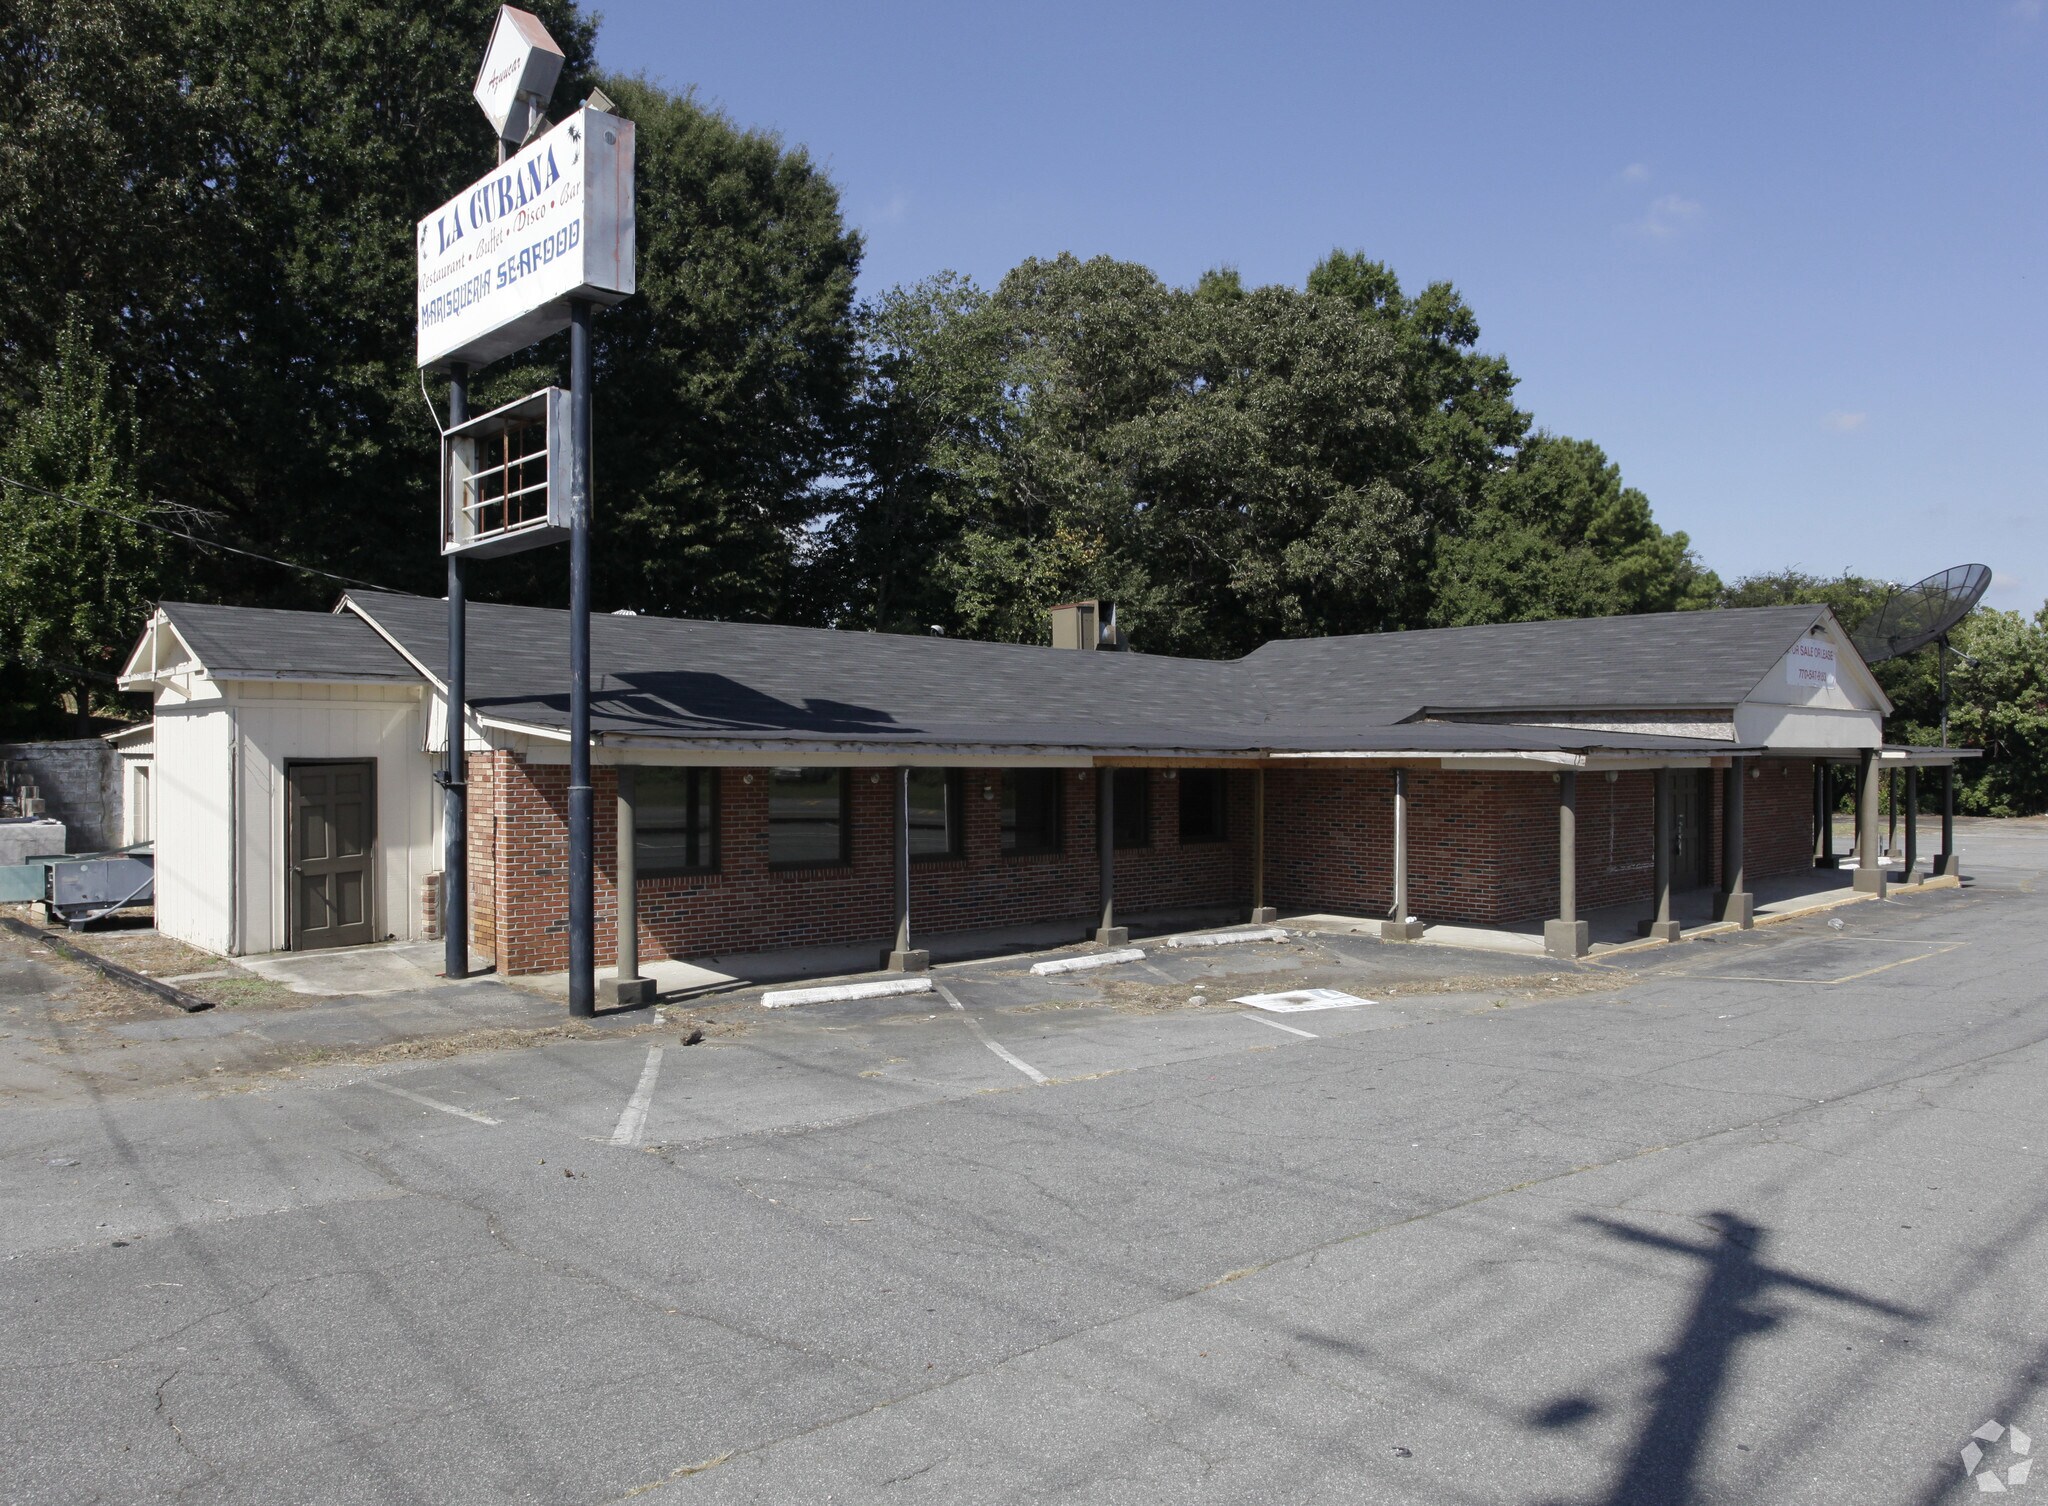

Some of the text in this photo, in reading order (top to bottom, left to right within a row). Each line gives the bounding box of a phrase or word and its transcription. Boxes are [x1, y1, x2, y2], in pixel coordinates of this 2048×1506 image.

[419, 181, 581, 293] Restaurant Buffet Disco Bar
[437, 143, 560, 257] LA CUBANA
[421, 218, 580, 331] MARISQUERIA SEAFOOD
[1800, 645, 1813, 657] SALE
[1821, 649, 1833, 661] LEASE
